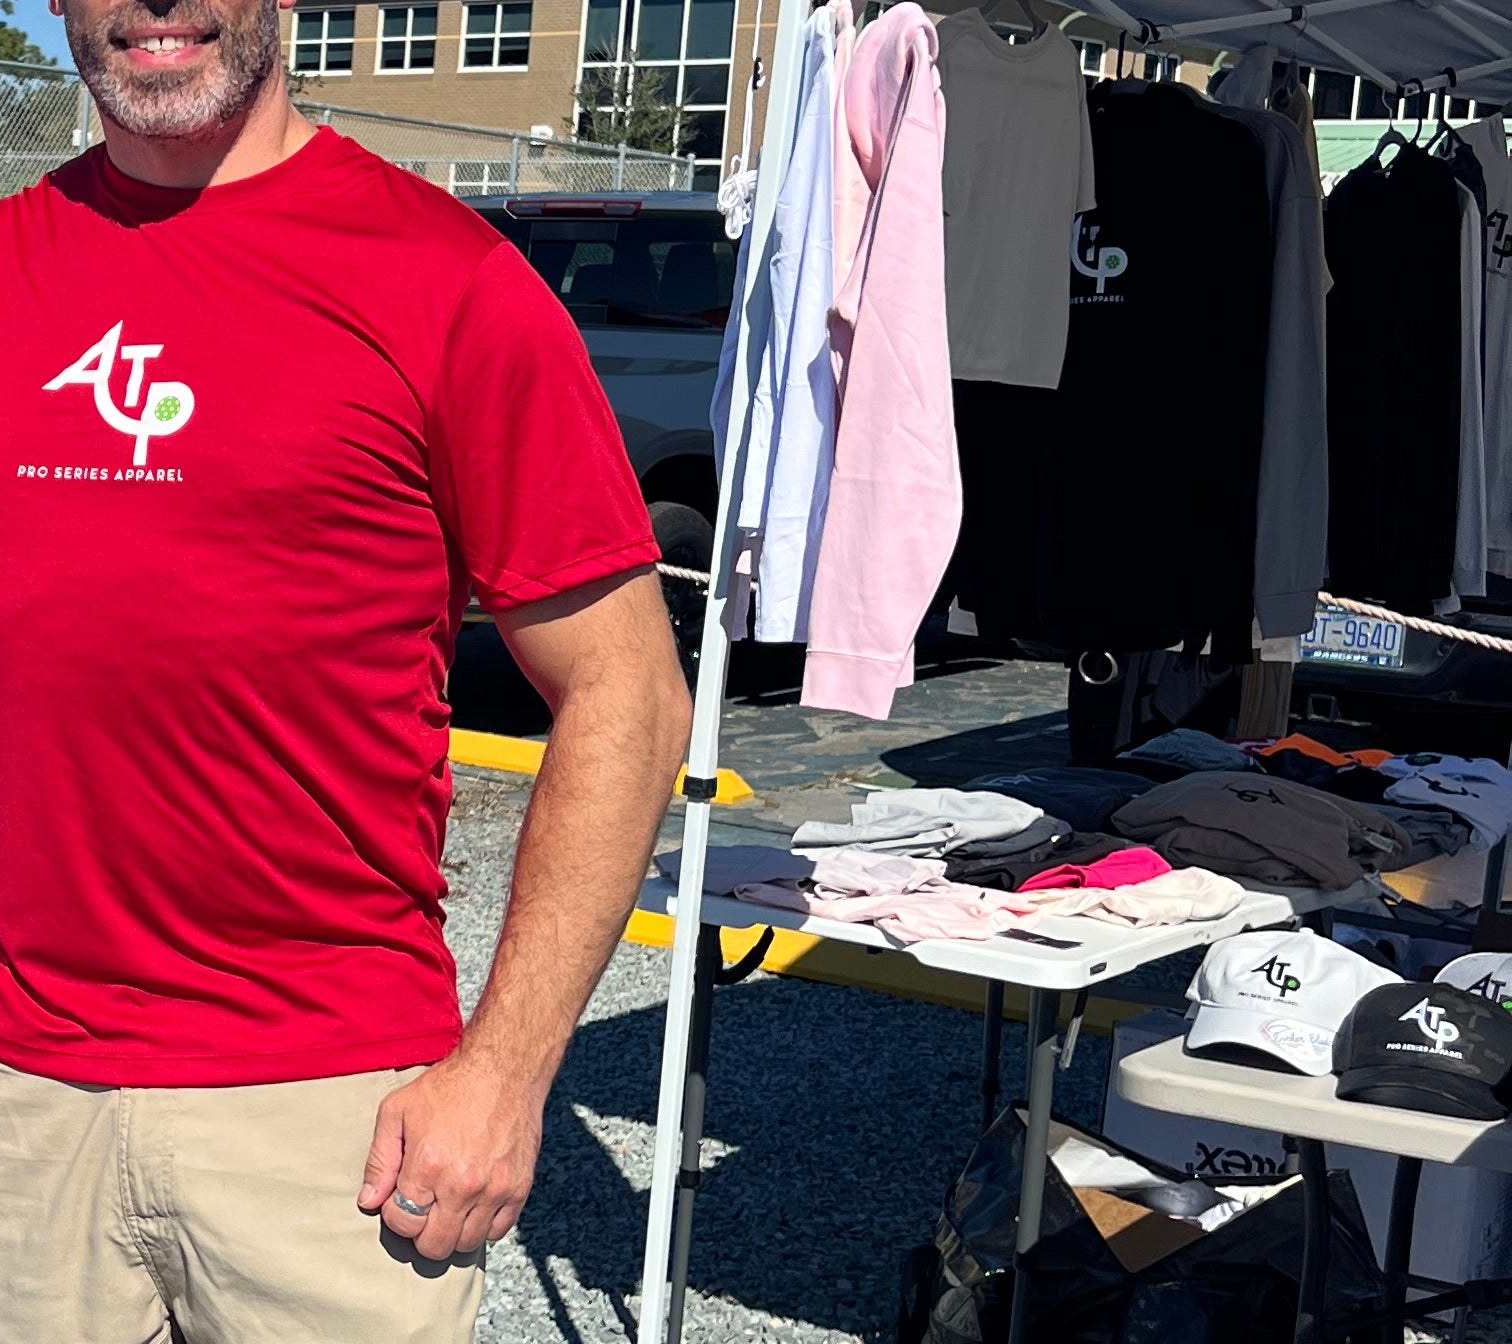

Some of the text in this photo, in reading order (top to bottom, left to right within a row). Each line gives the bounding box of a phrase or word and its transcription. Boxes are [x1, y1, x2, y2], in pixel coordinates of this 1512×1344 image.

[41, 319, 195, 466] ATP
[17, 465, 185, 483] PRO SERIES APPAREL
[1251, 954, 1301, 997] ATP
[1466, 971, 1512, 1006] AT
[1398, 997, 1460, 1050] ATP
